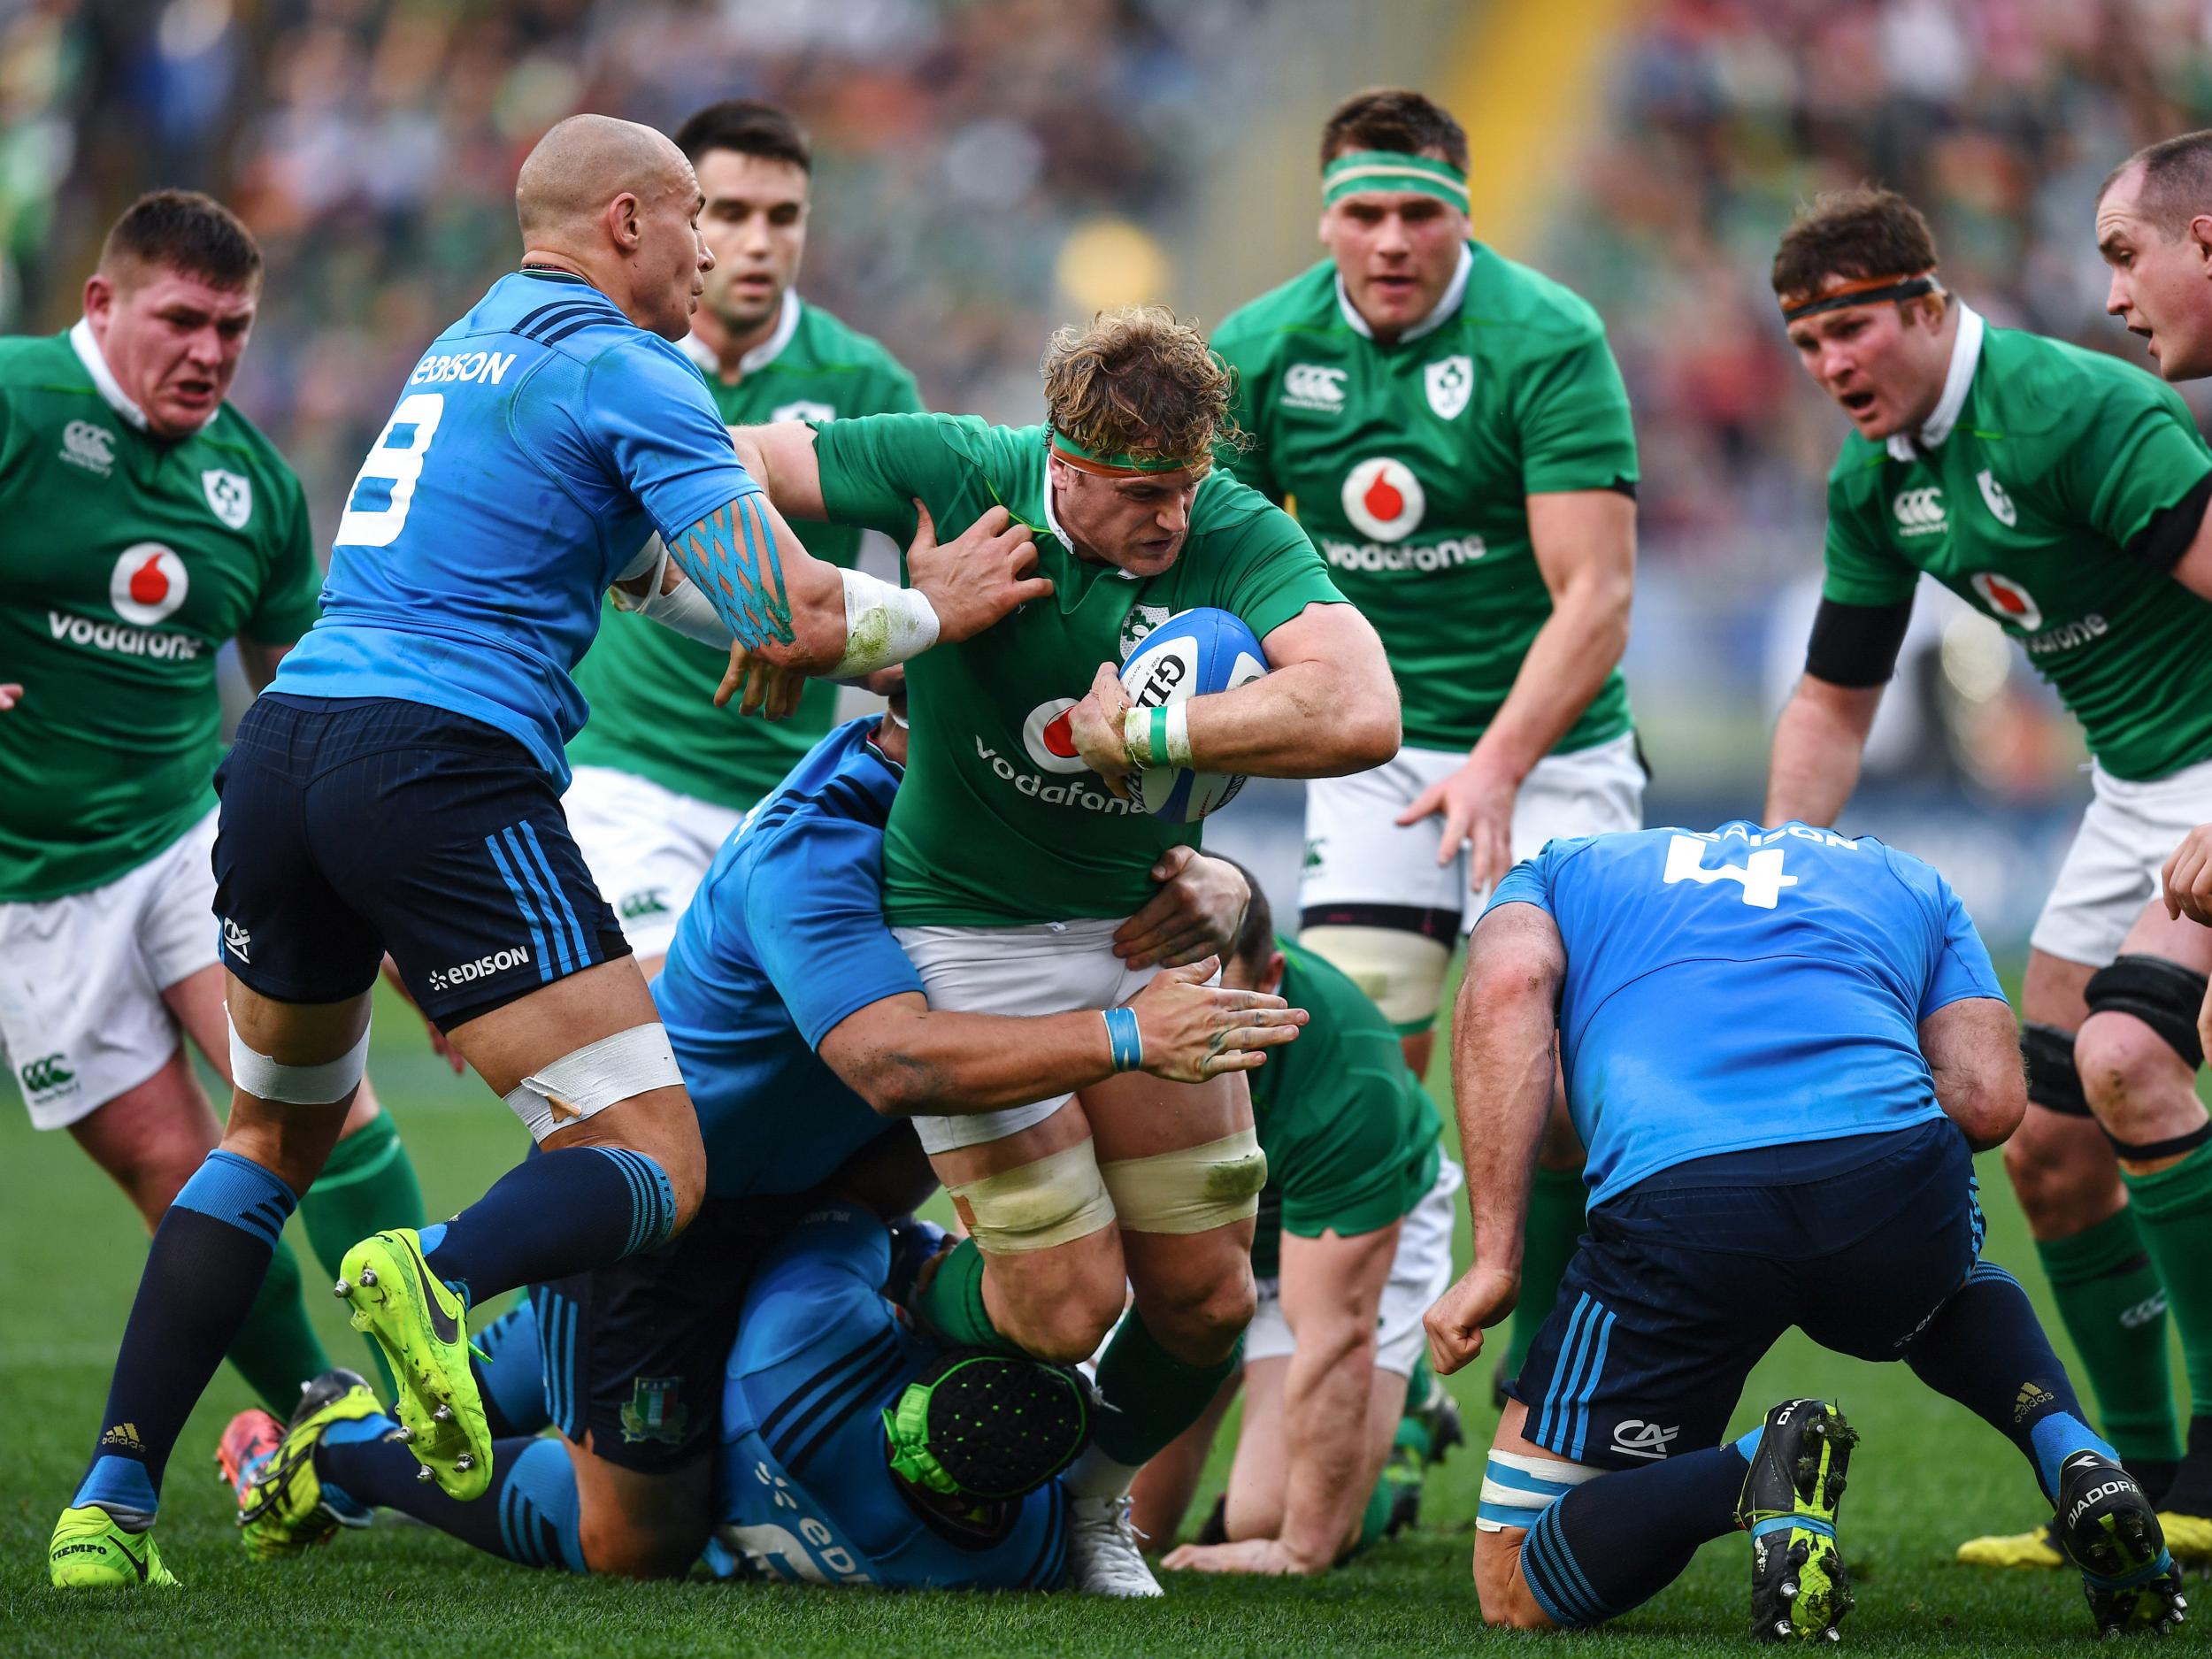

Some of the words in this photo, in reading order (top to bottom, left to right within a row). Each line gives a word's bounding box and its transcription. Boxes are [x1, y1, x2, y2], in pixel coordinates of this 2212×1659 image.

[335, 393, 444, 547] 8
[1321, 534, 1486, 572] vodafone
[1663, 834, 1798, 910] 4
[449, 945, 529, 984] eDISON
[2015, 1392, 2055, 1423] adidas
[102, 1434, 147, 1453] adidas
[2067, 1480, 2140, 1530] DIADORA
[52, 1543, 108, 1562] TIEMPO
